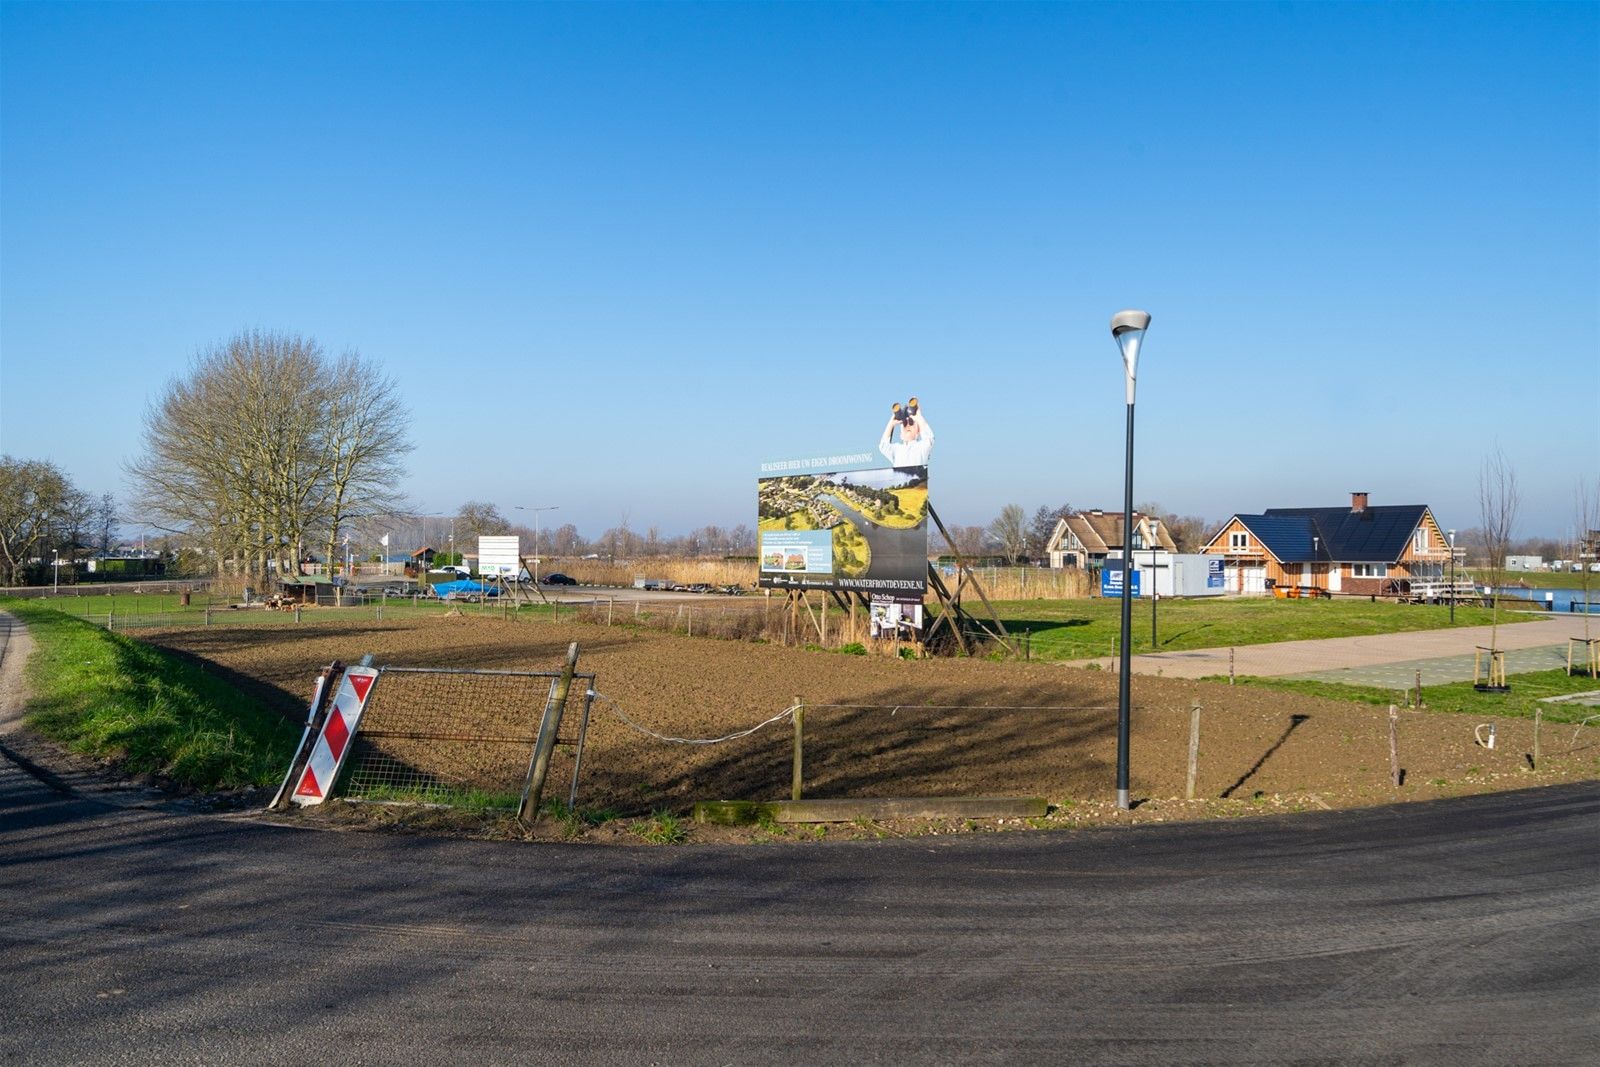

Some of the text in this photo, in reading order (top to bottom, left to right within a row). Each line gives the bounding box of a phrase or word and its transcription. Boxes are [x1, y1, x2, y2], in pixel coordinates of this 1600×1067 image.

[761, 453, 873, 472] REALISEER HIER UW EIGEN DROOMWONING
[839, 578, 924, 590] WWW.WATERFRONTDEVEENE.NL
